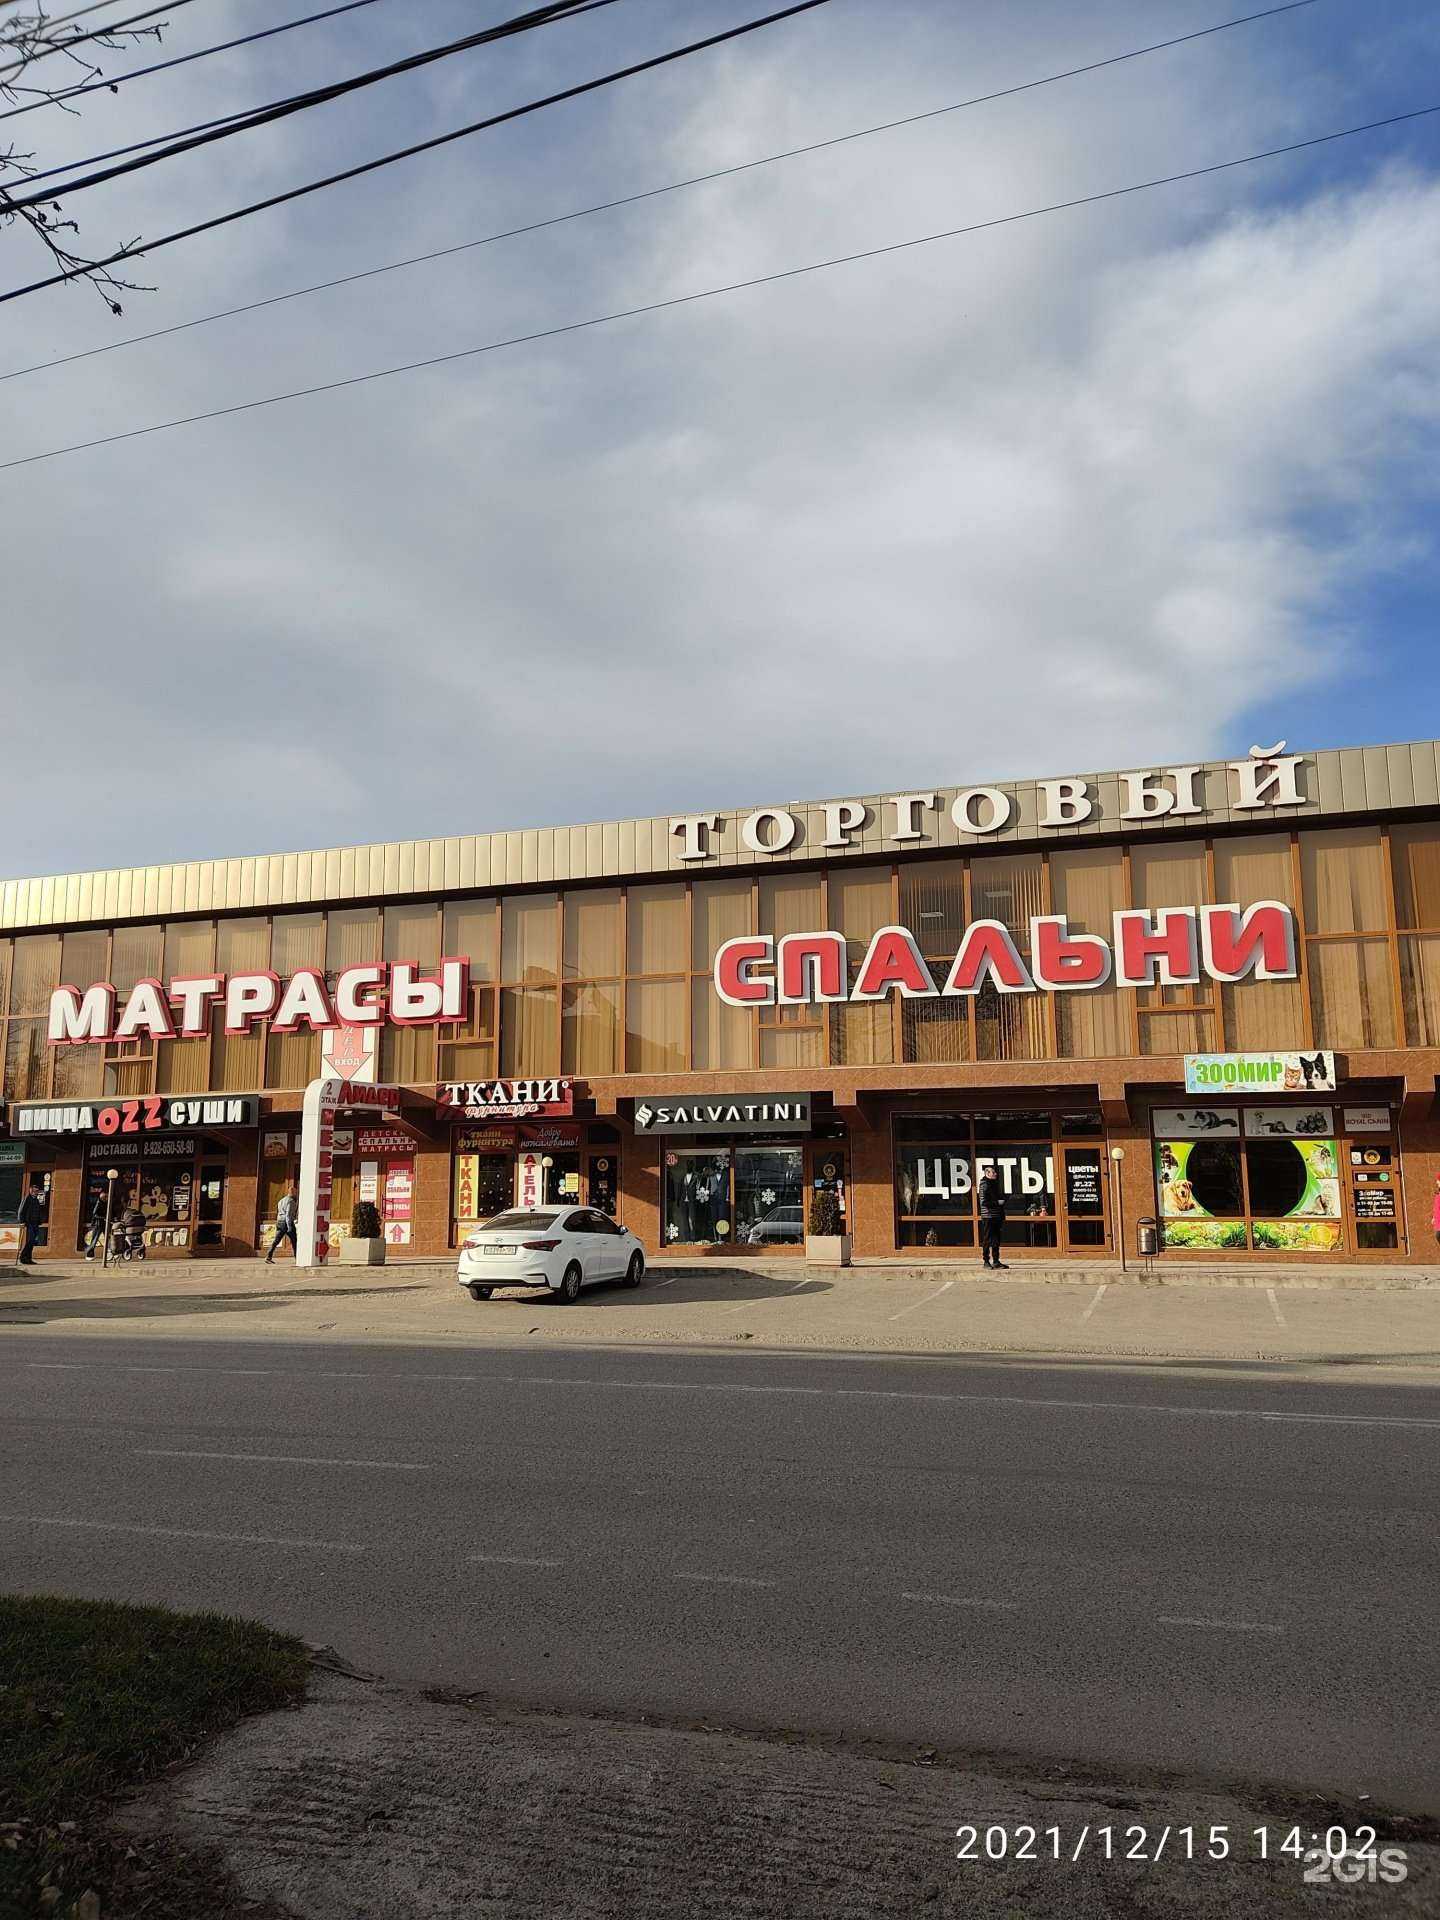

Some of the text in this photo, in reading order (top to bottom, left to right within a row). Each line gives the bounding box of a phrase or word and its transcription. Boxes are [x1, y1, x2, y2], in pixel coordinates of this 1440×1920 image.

[669, 740, 1306, 859] ТОРГОВЫЙ
[714, 901, 1297, 1006] СПАЛЬНИ
[47, 957, 469, 1046] МАТРАСЫ
[1196, 1062, 1283, 1084] ЗООМИР
[326, 1081, 333, 1095] 2
[445, 1079, 560, 1106] ТКАНИ
[18, 1106, 94, 1133] ПИЦЦА
[97, 1097, 163, 1135] OZZ
[170, 1100, 243, 1125] СУШИ
[656, 1103, 801, 1123] SALVATINI
[90, 1143, 138, 1158] ДОСТАВКА
[459, 1156, 473, 1217] ТКАНИ
[523, 1154, 537, 1206] АТЕЛЬ
